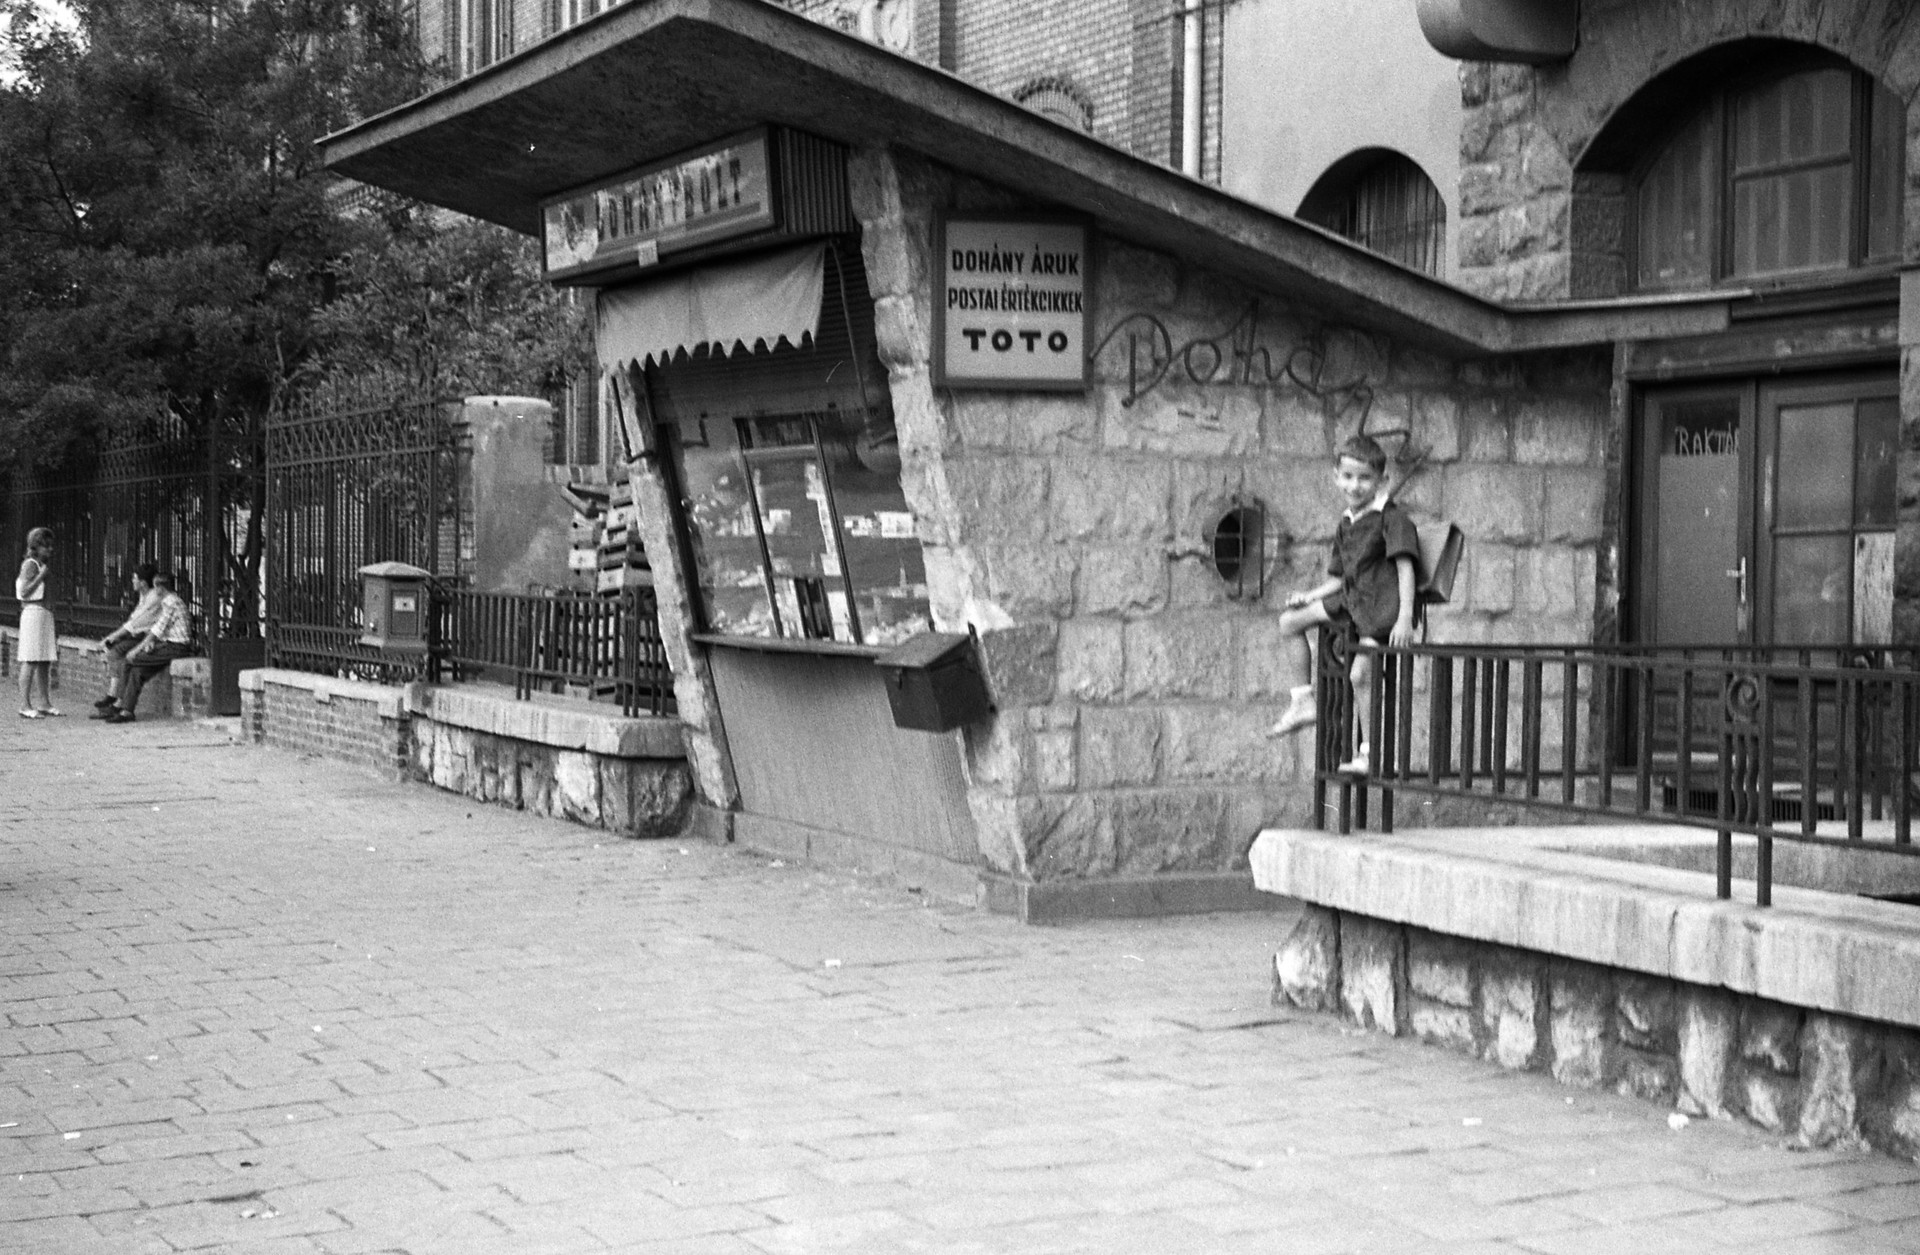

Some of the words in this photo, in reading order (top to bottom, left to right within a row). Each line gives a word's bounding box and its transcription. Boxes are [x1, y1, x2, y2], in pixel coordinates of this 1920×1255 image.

[952, 242, 1025, 274] DOHÁNY
[1031, 243, 1079, 275] ÁRUK
[948, 287, 998, 312] POSTAI
[1002, 281, 1083, 313] ÉRTÉKCIKKEK
[962, 328, 1069, 353] TOTO
